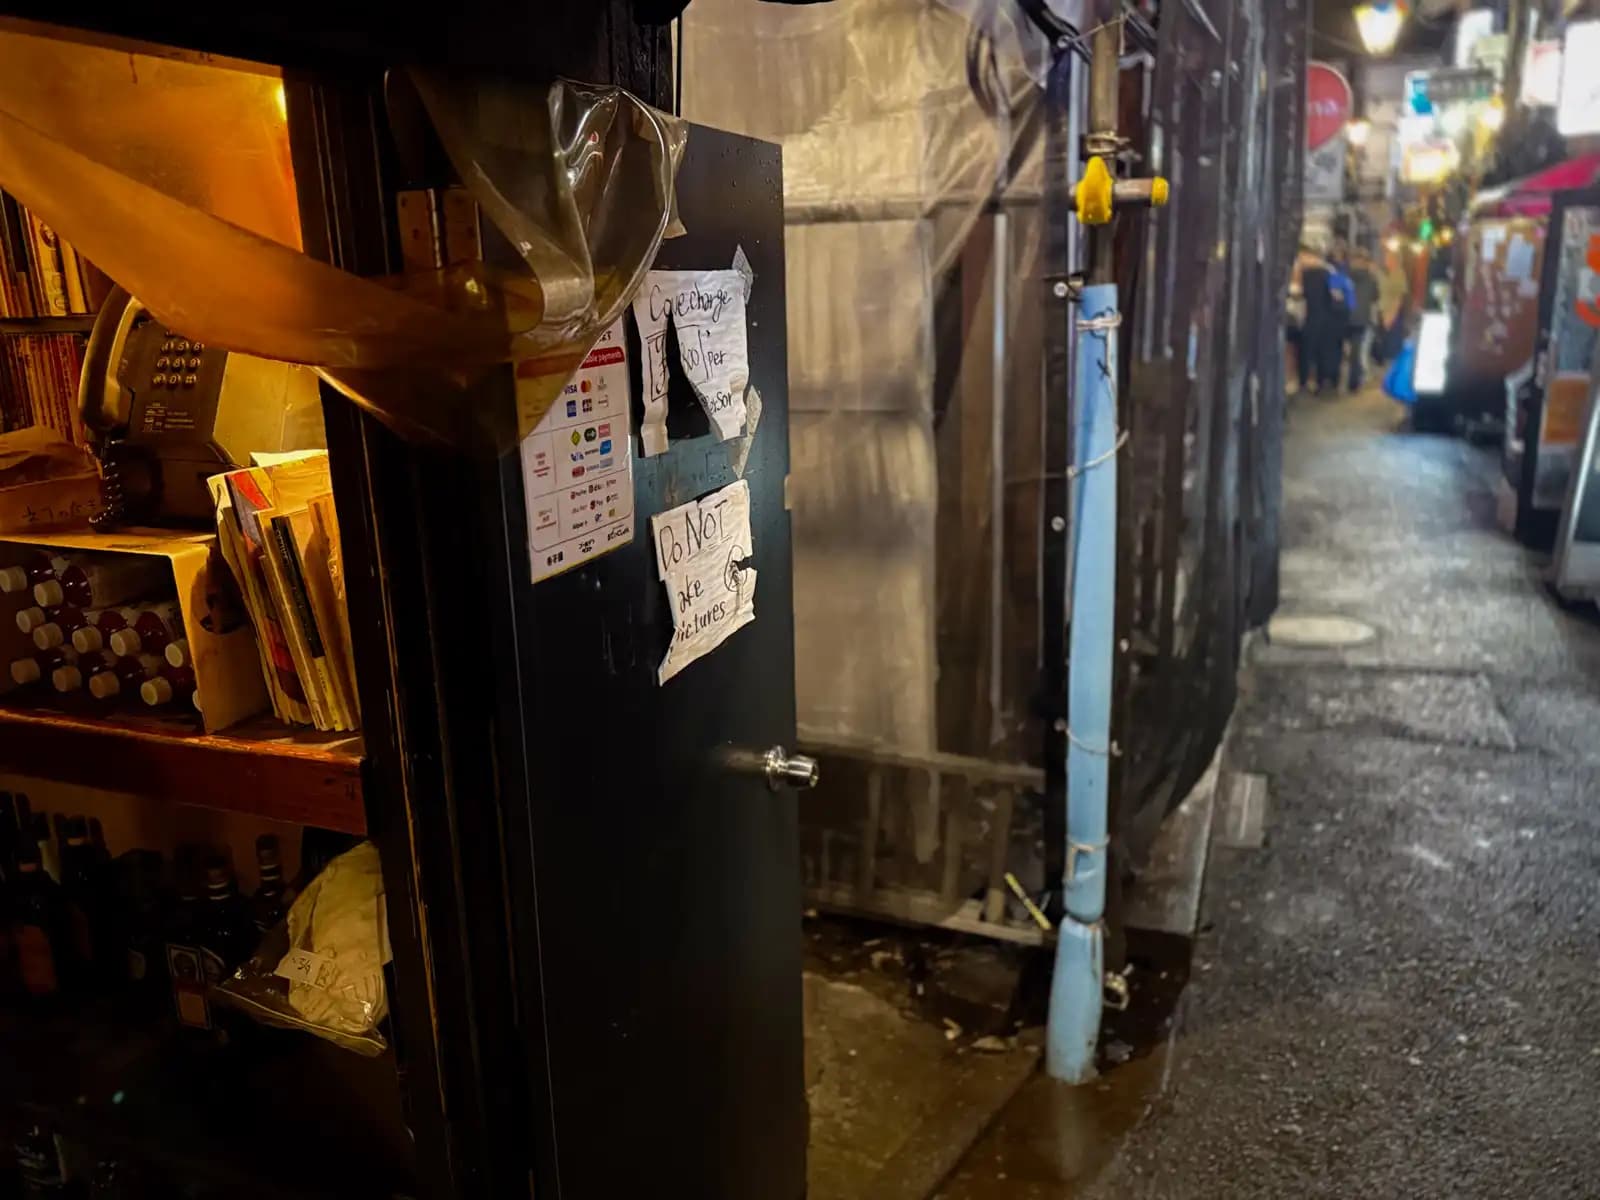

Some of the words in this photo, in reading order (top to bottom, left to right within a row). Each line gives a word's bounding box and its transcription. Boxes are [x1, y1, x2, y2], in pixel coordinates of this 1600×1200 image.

[707, 350, 728, 377] per
[659, 525, 683, 572] Do
[677, 574, 704, 614] ake
